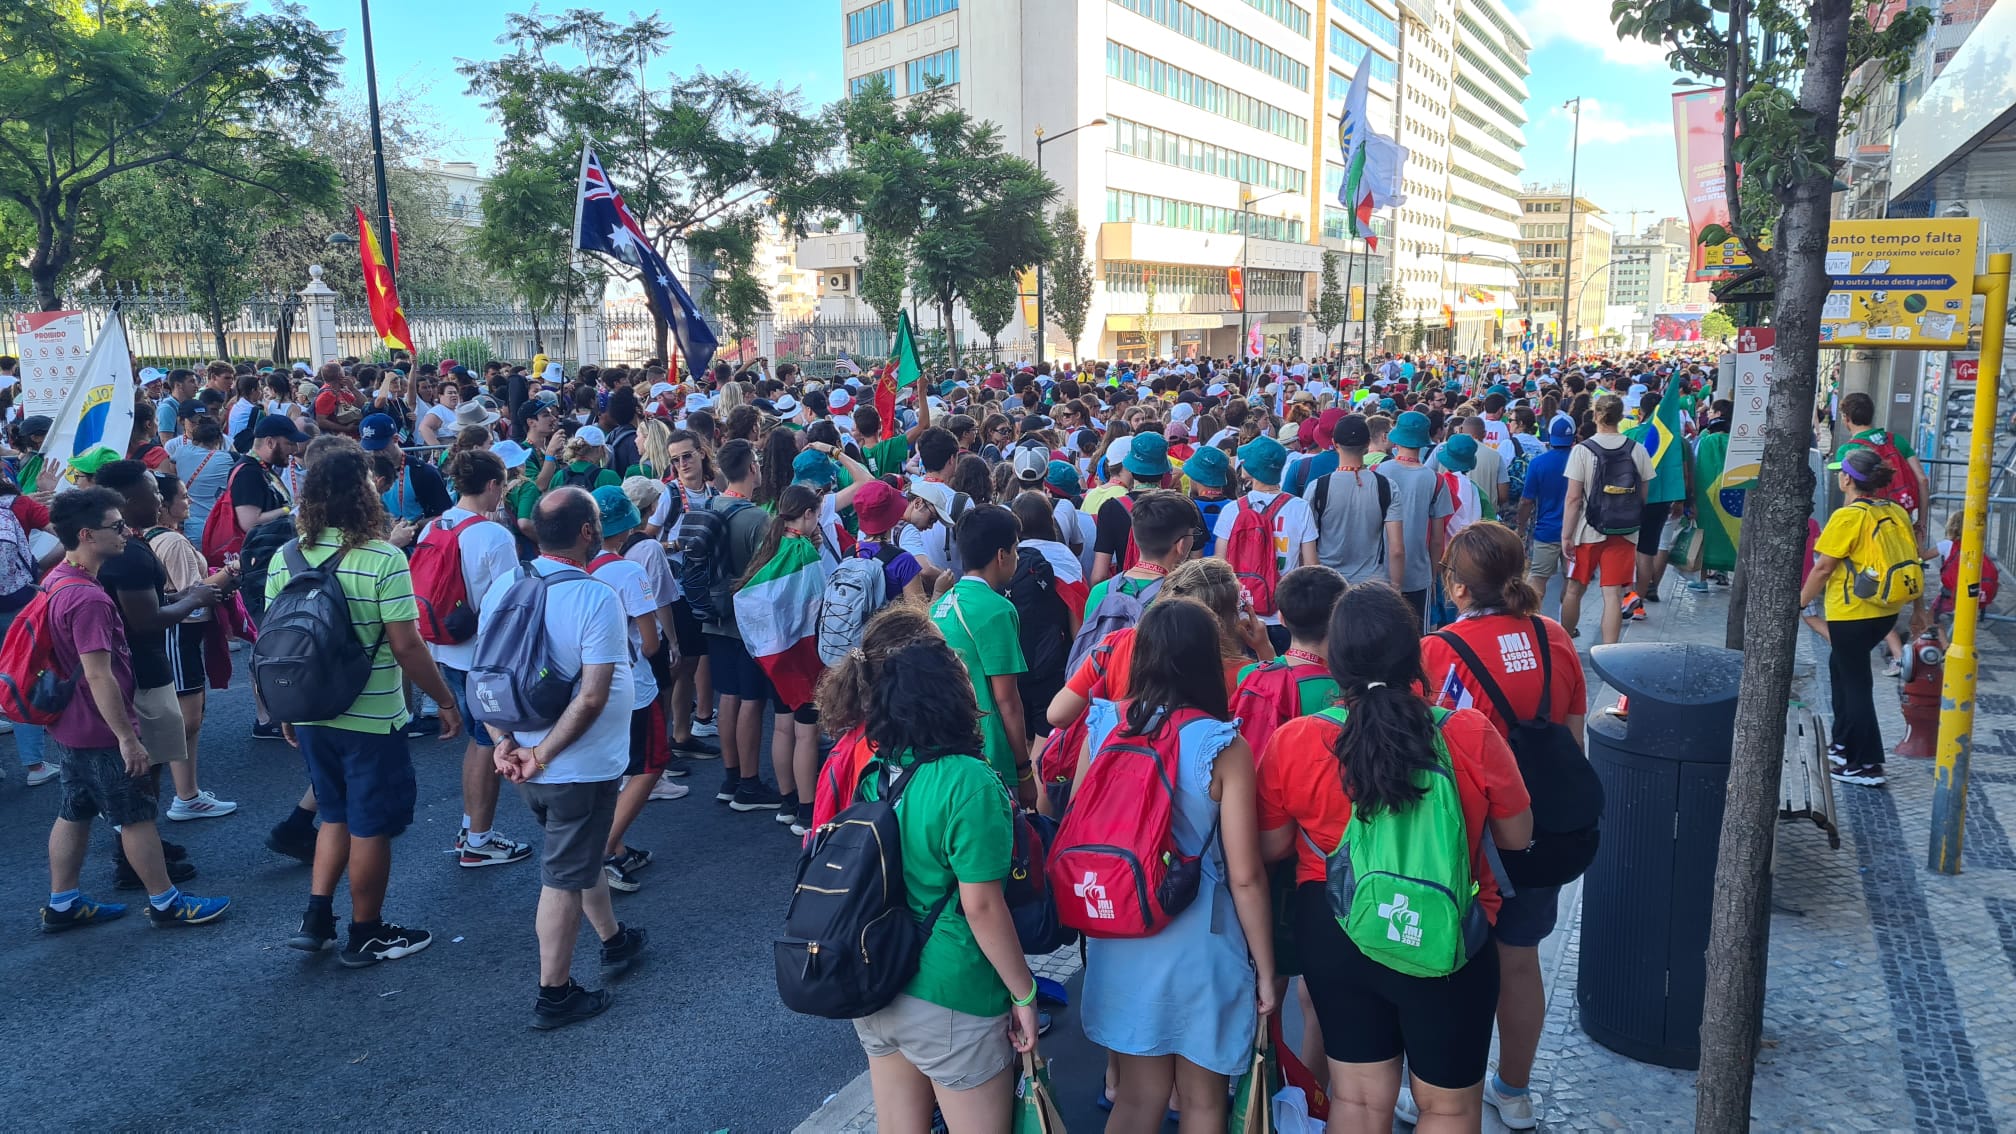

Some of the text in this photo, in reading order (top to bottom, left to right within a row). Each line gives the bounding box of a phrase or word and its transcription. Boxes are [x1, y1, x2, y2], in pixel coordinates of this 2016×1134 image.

[1829, 231, 1962, 246] anto tempo falta
[1875, 249, 1917, 259] próximo
[1871, 278, 1890, 286] face
[1891, 278, 1915, 286] deste
[1917, 278, 1948, 287] painel!
[1497, 631, 1531, 654] JMJ
[1501, 649, 1535, 662] LISBOA
[1504, 657, 1538, 673] 2023
